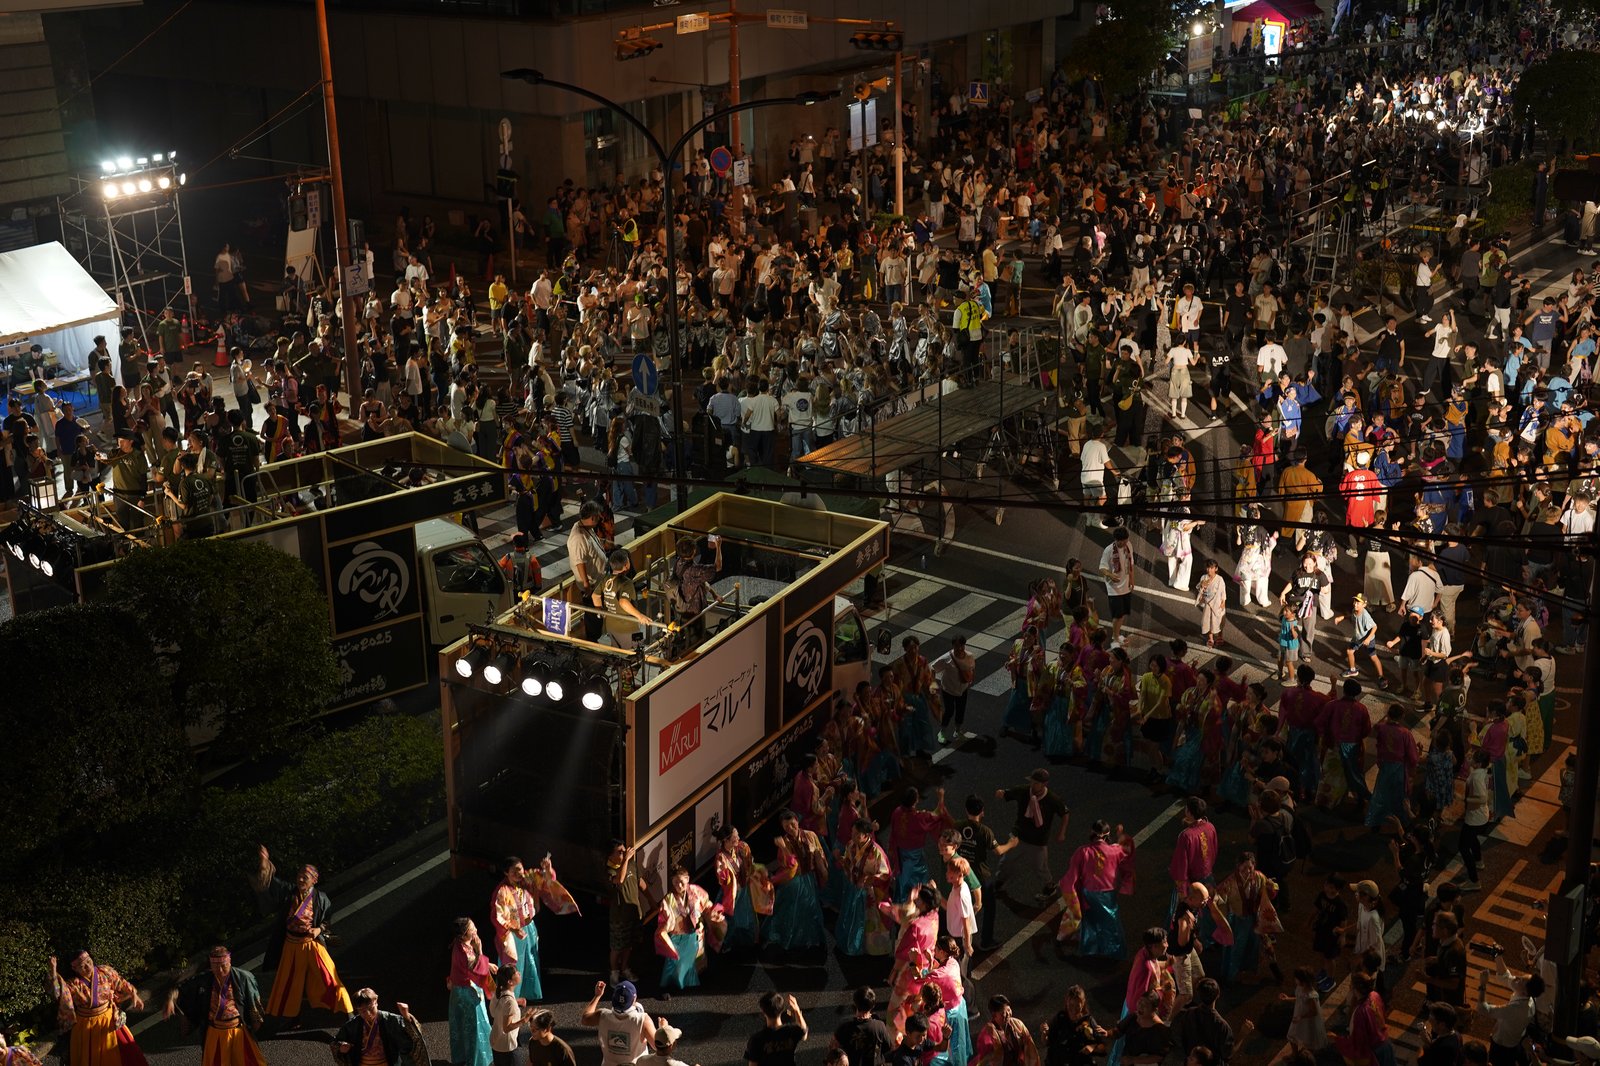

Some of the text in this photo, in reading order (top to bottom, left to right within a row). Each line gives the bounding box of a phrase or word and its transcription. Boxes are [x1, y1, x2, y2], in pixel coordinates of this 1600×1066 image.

[452, 481, 494, 505] 五号車
[703, 663, 758, 708] スーパーマーケット
[703, 675, 755, 732] マルイ
[661, 721, 700, 769] MARUI
